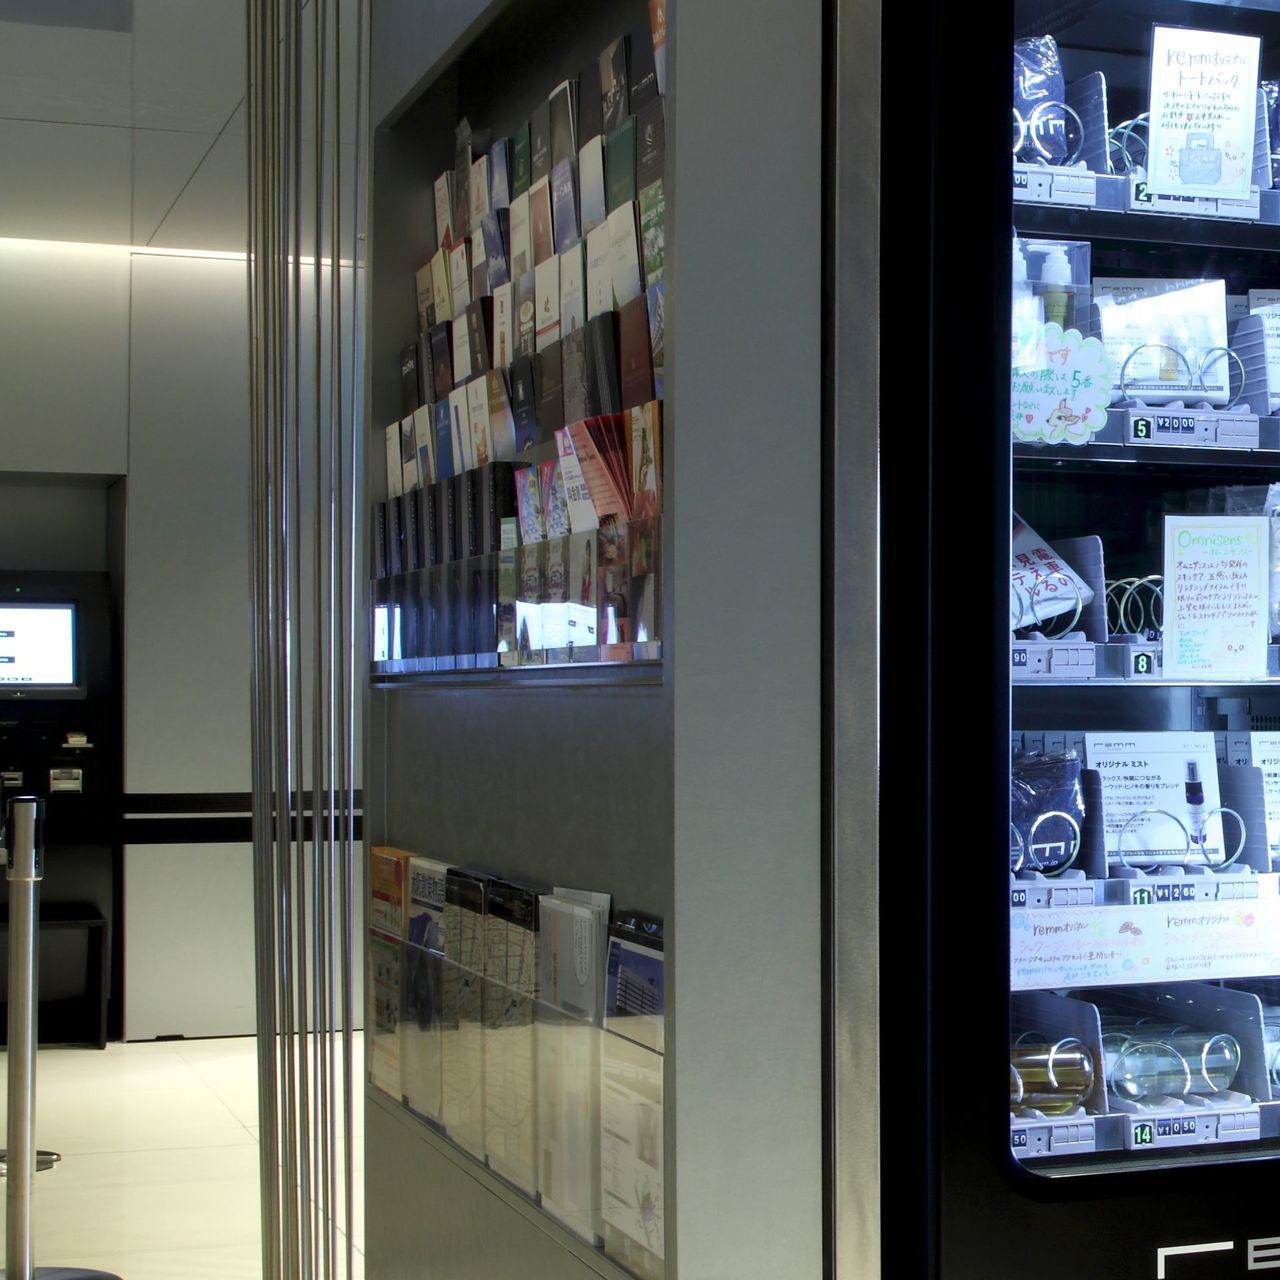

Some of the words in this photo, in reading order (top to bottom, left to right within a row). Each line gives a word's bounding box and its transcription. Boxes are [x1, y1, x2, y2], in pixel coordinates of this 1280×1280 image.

[1138, 186, 1148, 201] 2
[1137, 420, 1146, 438] 5
[1157, 418, 1195, 429] ¥2000
[1178, 530, 1243, 548] Omnisens
[1138, 655, 1148, 672] 8
[1095, 760, 1130, 769] オリジナル
[1131, 760, 1150, 768] ミスト
[1135, 891, 1149, 905] 11
[1157, 887, 1196, 898] ¥1260
[1135, 1127, 1151, 1143] 14
[1158, 1121, 1196, 1135] ¥1050
